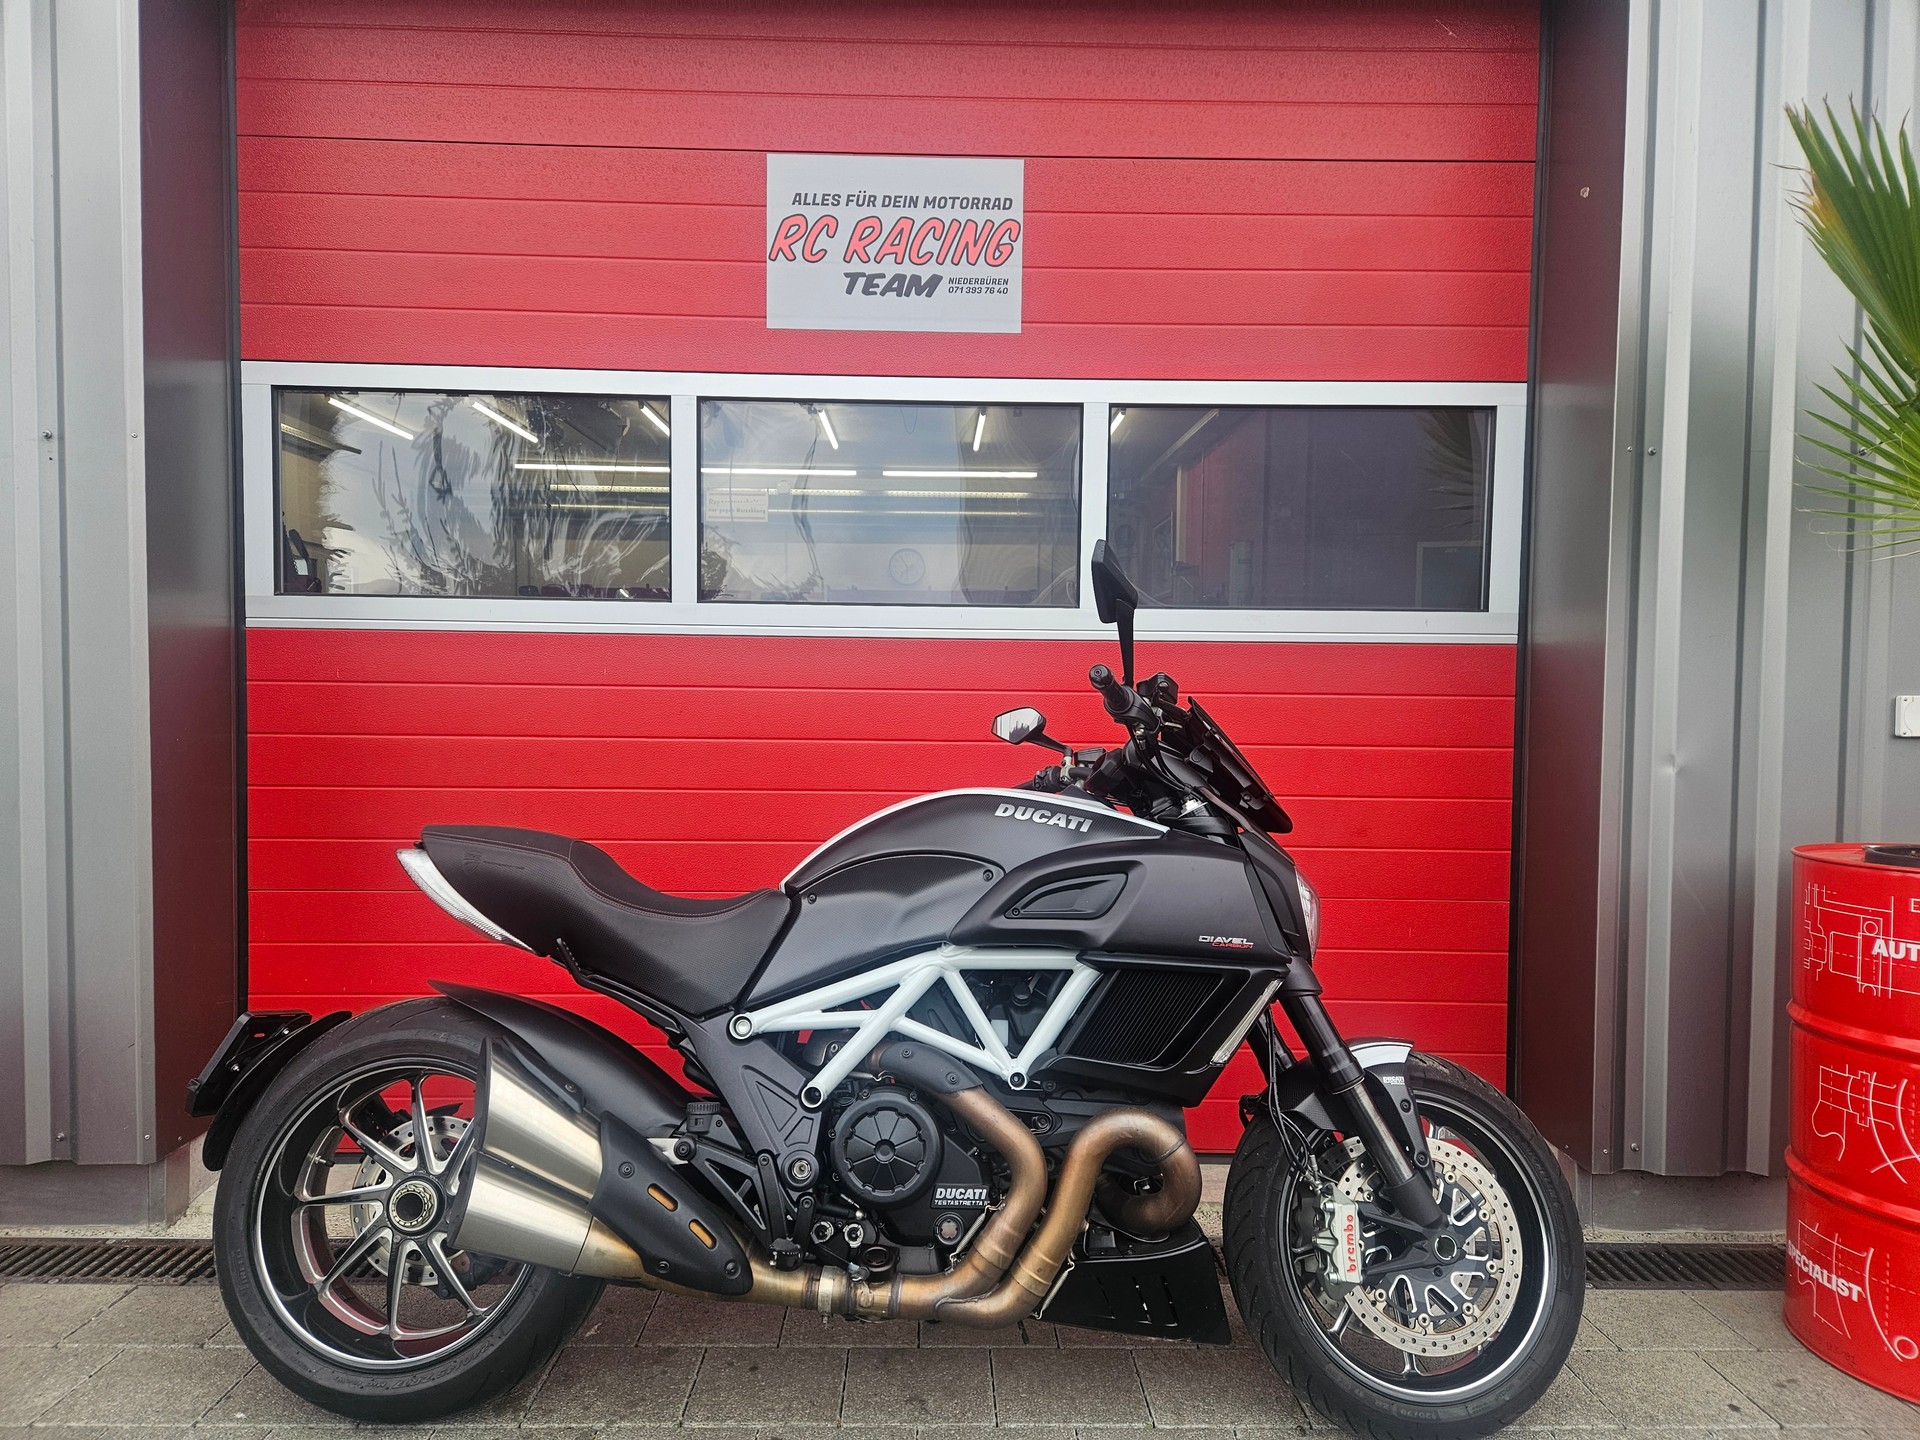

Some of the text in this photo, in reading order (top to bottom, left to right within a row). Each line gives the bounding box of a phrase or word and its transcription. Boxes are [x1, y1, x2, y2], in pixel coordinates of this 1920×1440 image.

[792, 190, 1013, 210] ALLES FÜR DEIN MOTORRAD
[768, 214, 1022, 267] RC RACING
[844, 272, 944, 298] TEAM
[948, 276, 1009, 286] NIEDERBÜREN
[994, 803, 1092, 832] DUCATI
[1198, 936, 1254, 945] DIAVEL
[936, 1188, 987, 1200] DUCATI
[1344, 1214, 1356, 1272] brembo
[1788, 1240, 1862, 1302] SPECIALIST
